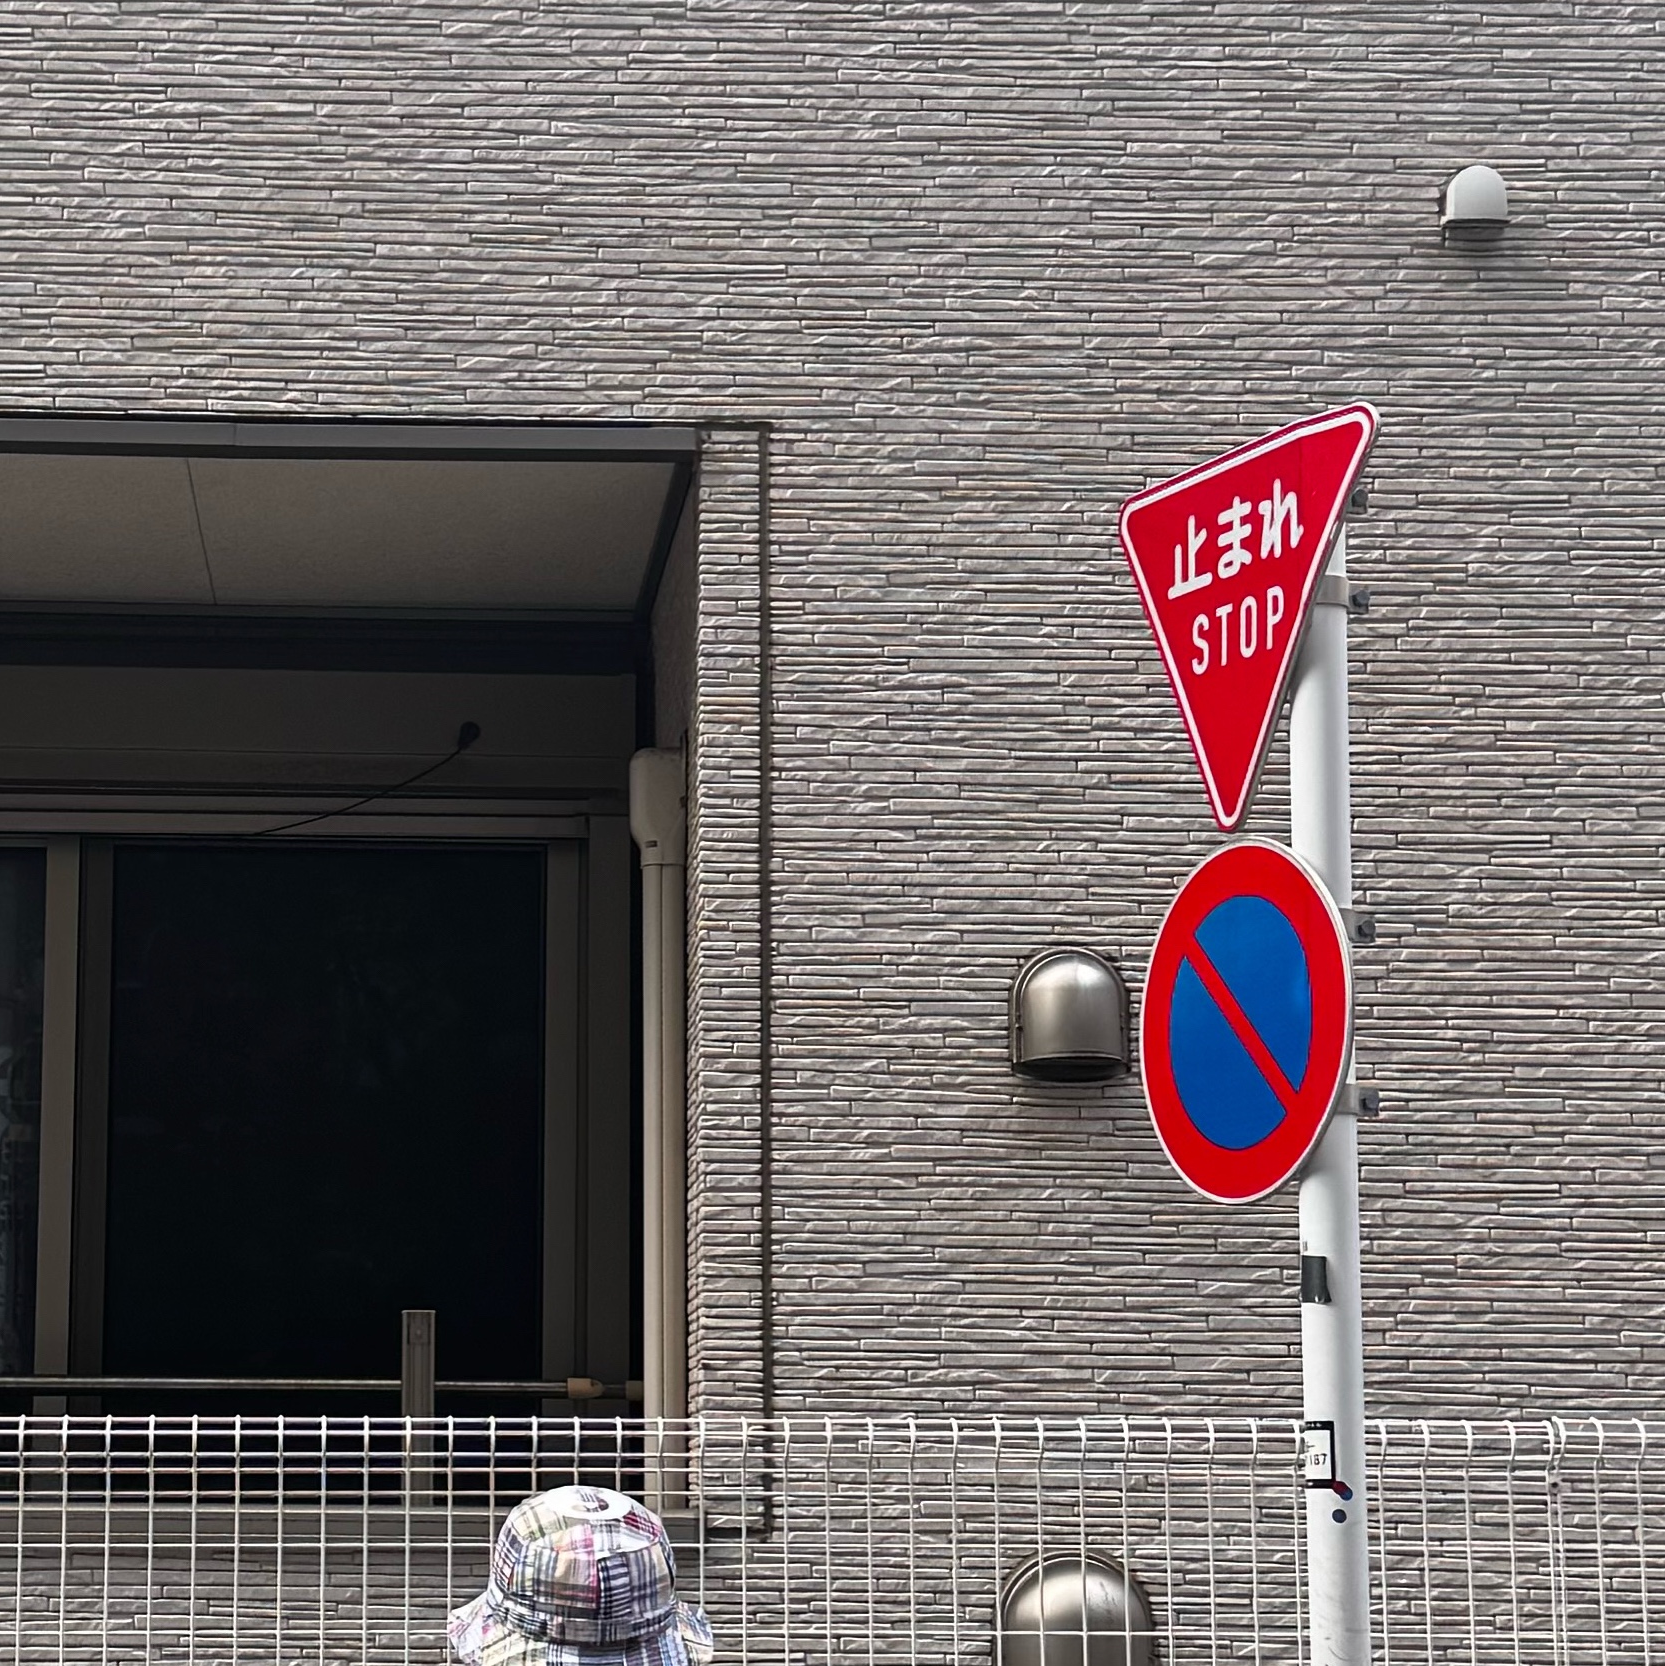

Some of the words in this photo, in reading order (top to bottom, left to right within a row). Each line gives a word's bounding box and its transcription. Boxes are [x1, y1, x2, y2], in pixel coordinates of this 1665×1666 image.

[1167, 478, 1304, 600] 止まれ
[1191, 585, 1285, 676] STOP
